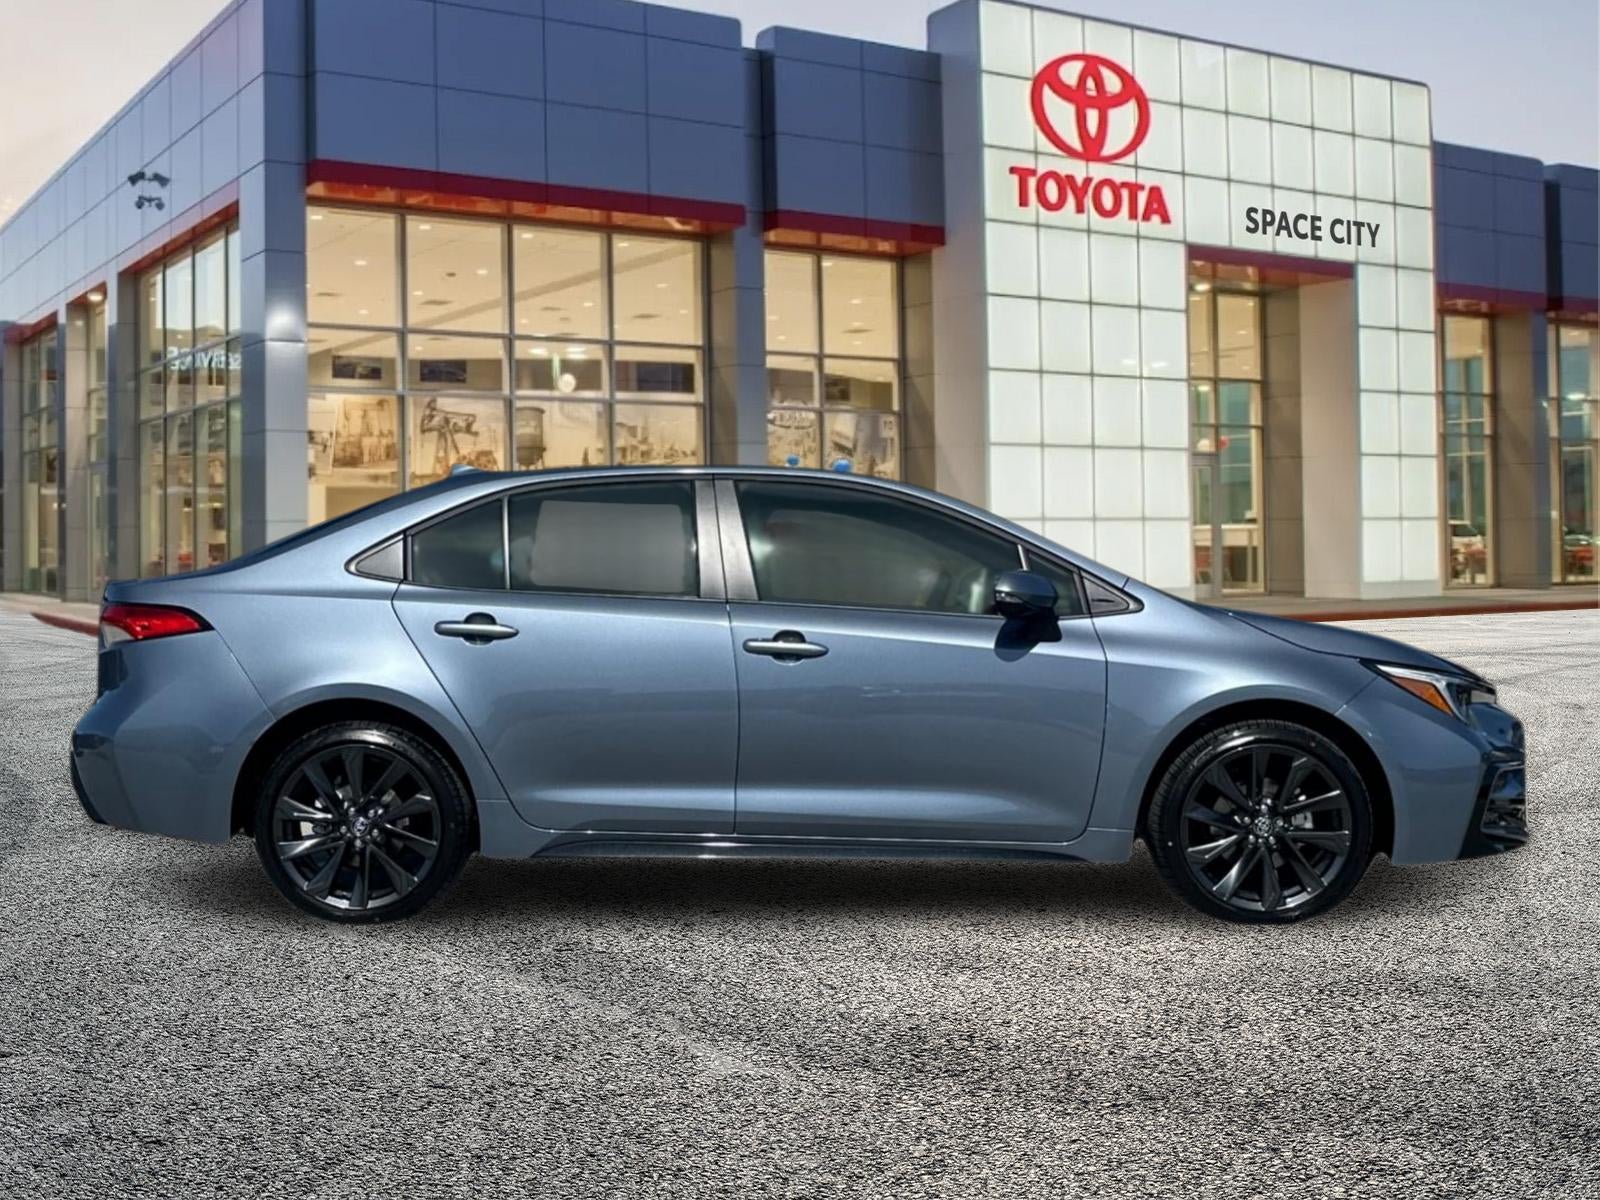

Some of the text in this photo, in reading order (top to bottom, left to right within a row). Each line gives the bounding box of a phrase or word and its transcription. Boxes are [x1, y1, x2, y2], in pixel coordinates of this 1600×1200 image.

[1009, 166, 1171, 224] TOYOTA
[1245, 206, 1380, 248] SPACE CITY
